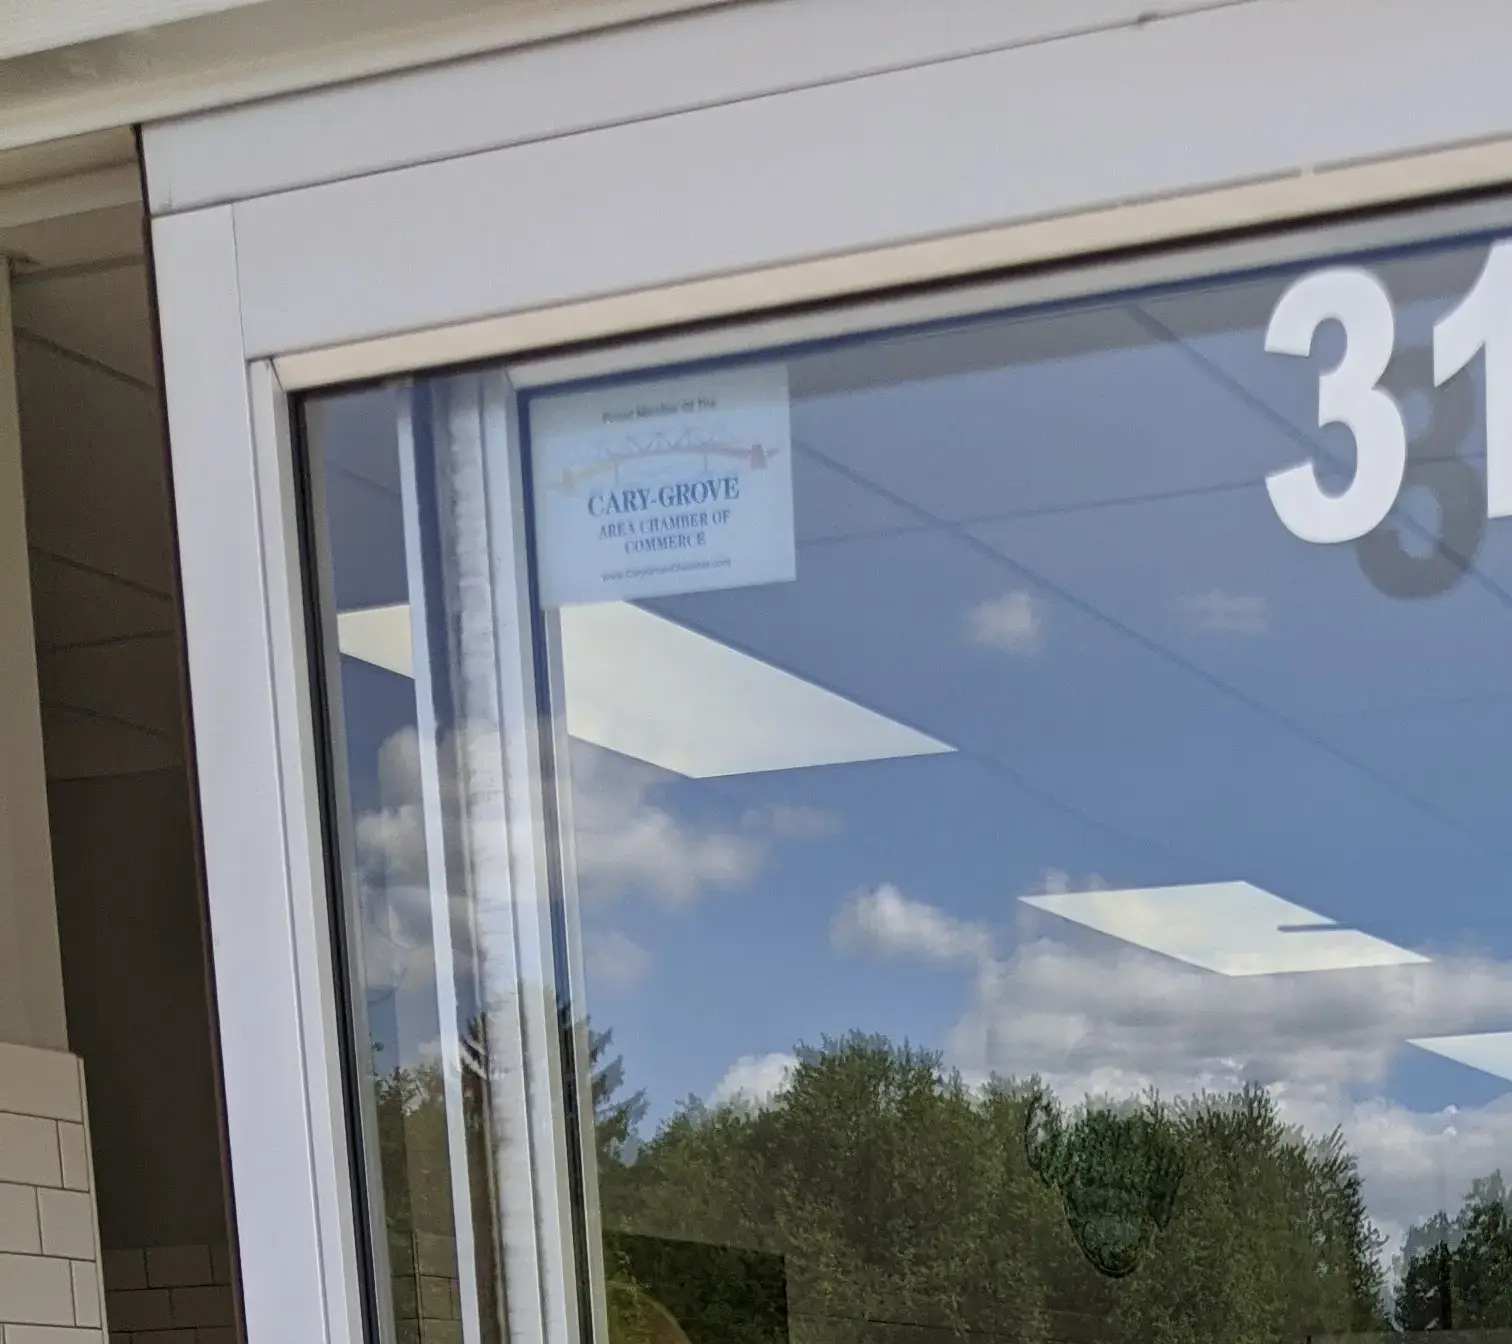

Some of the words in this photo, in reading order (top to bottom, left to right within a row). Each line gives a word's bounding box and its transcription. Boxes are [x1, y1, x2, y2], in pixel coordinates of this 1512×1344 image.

[588, 476, 741, 517] CARY-GROVE
[599, 520, 637, 540] AREA
[640, 511, 708, 534] CHAMBER
[712, 509, 731, 525] OF
[625, 530, 706, 555] COMMERCE
